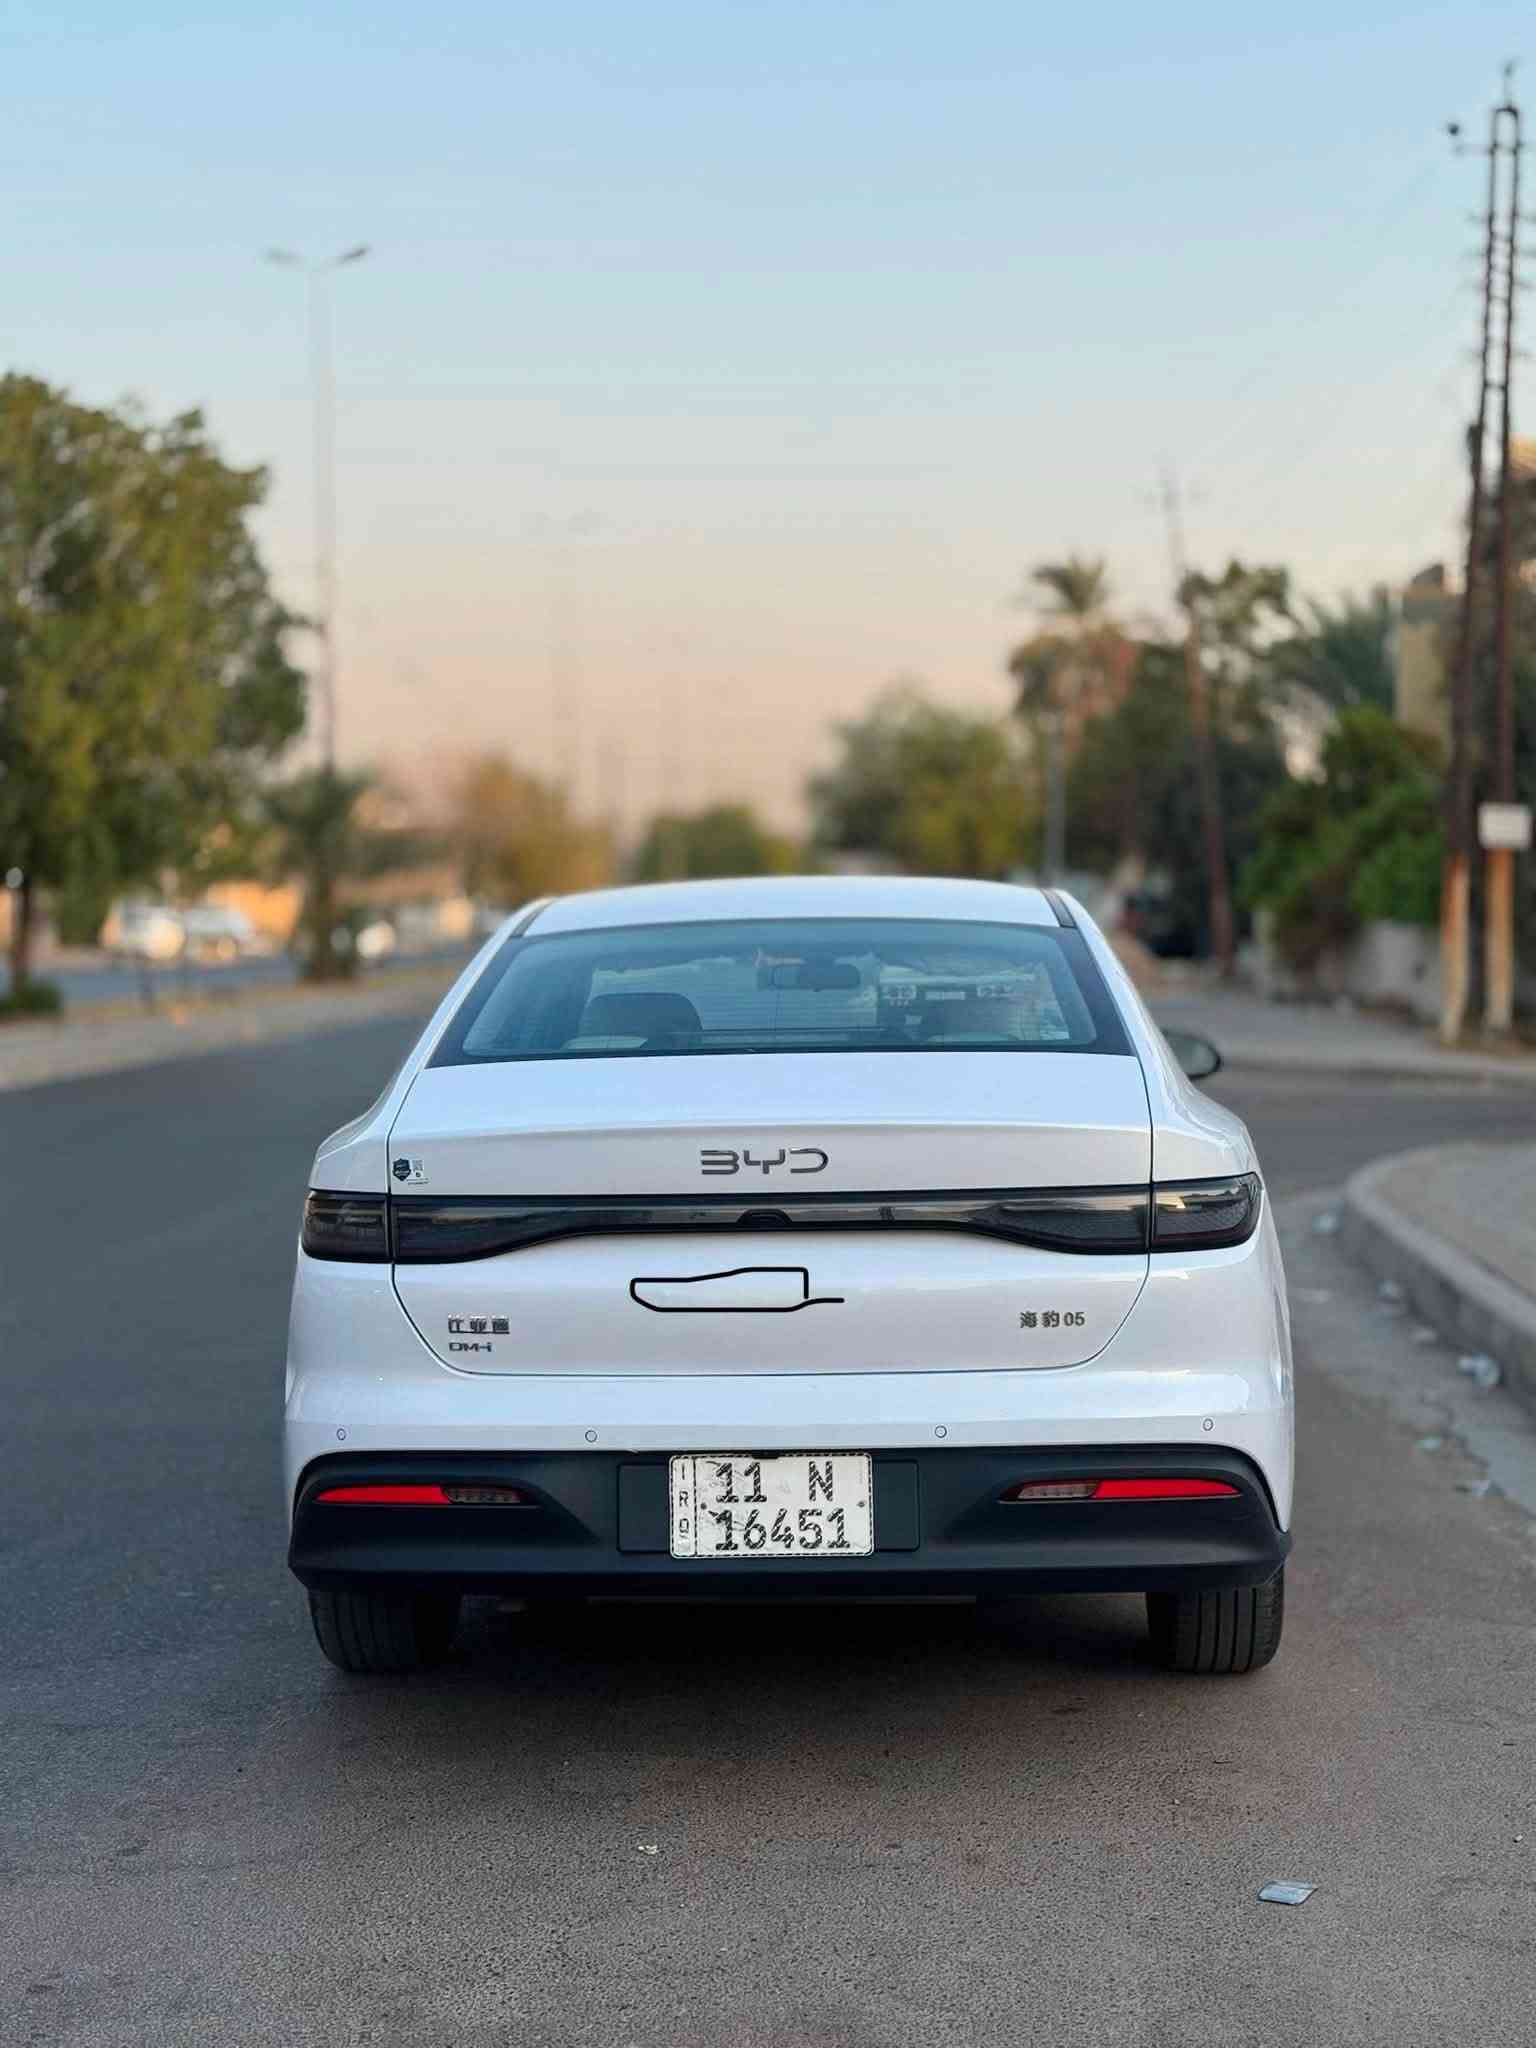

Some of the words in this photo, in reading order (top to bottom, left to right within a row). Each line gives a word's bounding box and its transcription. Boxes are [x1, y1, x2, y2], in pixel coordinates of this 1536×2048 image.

[701, 1148, 829, 1175] BYD
[716, 1462, 767, 1503] 11
[808, 1461, 834, 1501] N
[715, 1508, 850, 1551] 16451
